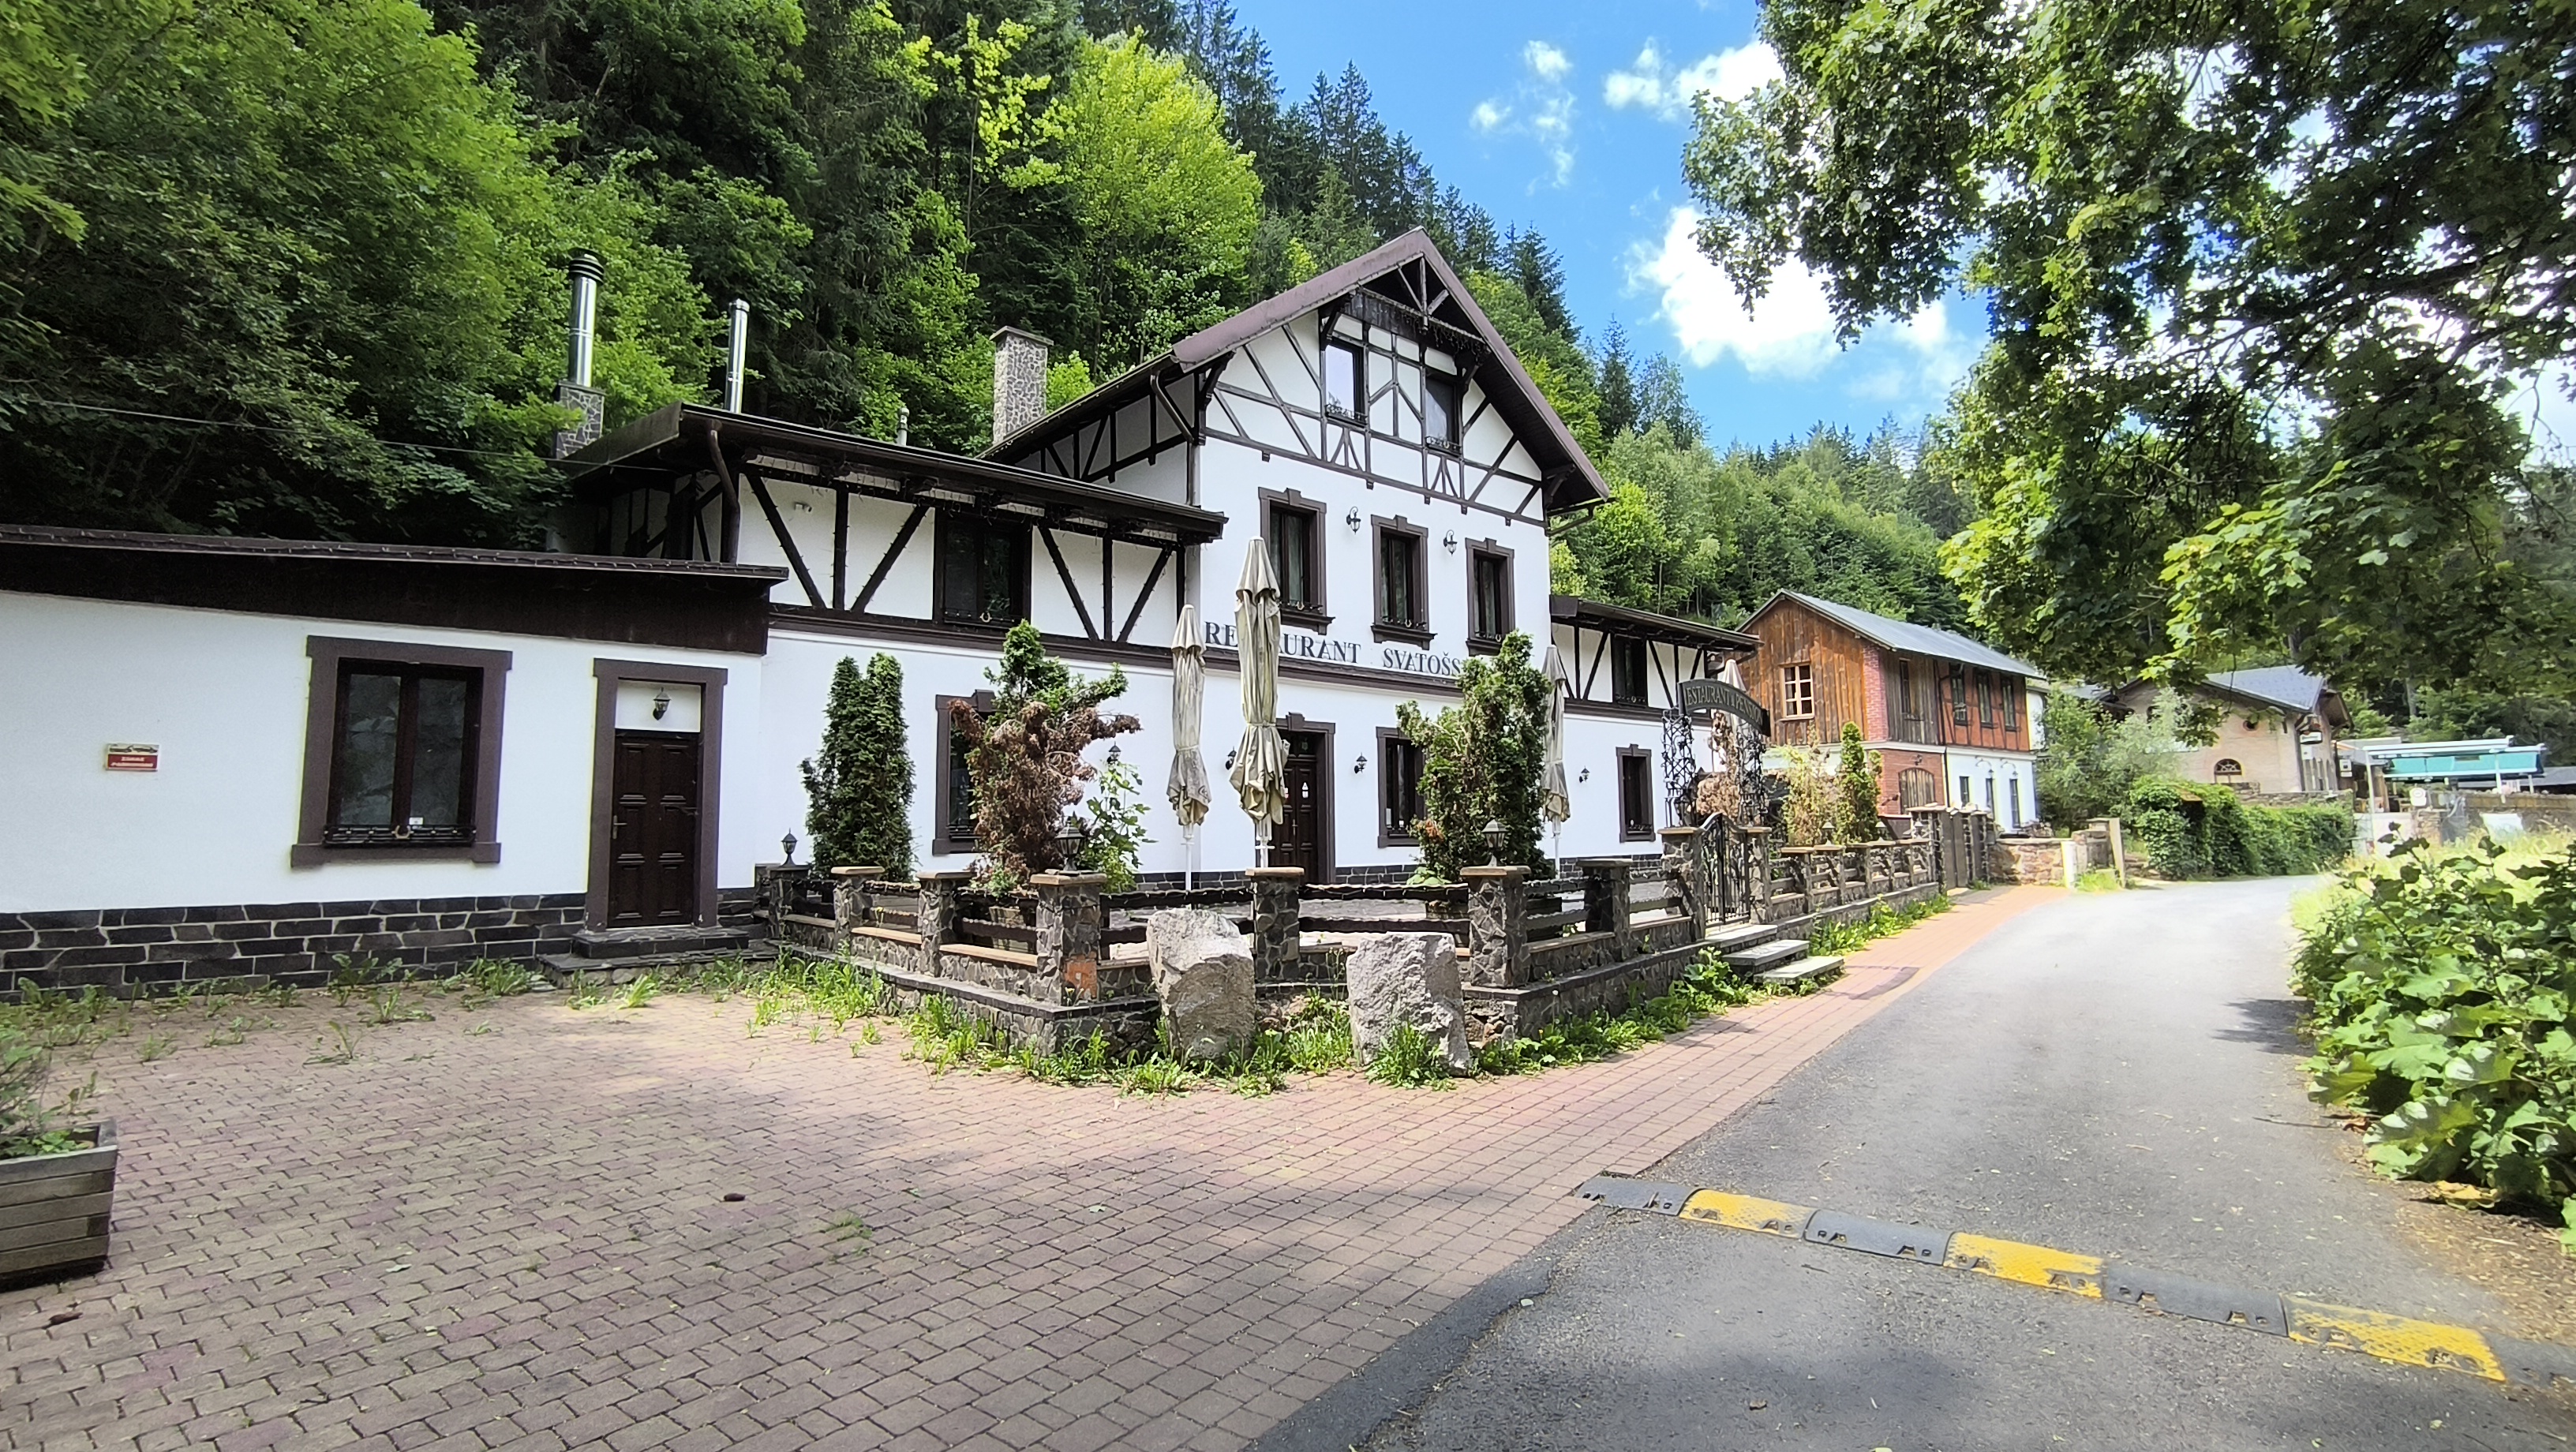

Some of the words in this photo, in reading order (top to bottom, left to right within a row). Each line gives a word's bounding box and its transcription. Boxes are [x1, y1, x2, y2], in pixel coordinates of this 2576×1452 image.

[1204, 621, 1361, 664] REURANT
[1383, 648, 1462, 676] SVATOŠS
[1686, 685, 1730, 705] ESTAURANT
[1735, 692, 1763, 725] PENSION
